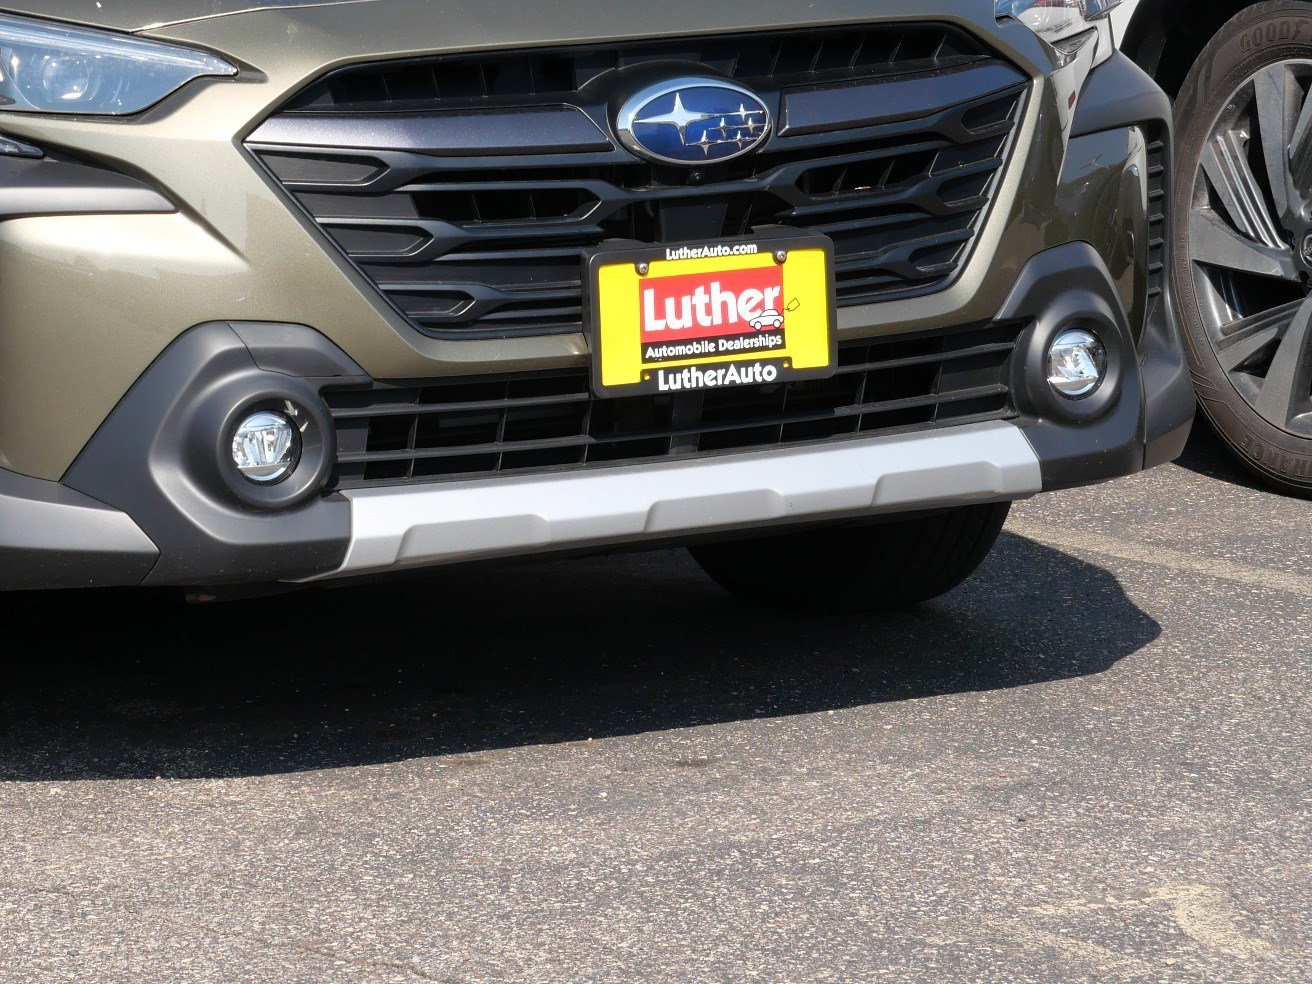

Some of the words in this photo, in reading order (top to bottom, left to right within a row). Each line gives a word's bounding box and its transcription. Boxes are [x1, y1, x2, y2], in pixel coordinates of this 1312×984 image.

[665, 243, 758, 261] LutherAuto.com
[643, 281, 781, 332] Luther
[645, 339, 716, 359] Automobile
[718, 333, 783, 352] Dealerships
[658, 363, 777, 391] LutherAuto
